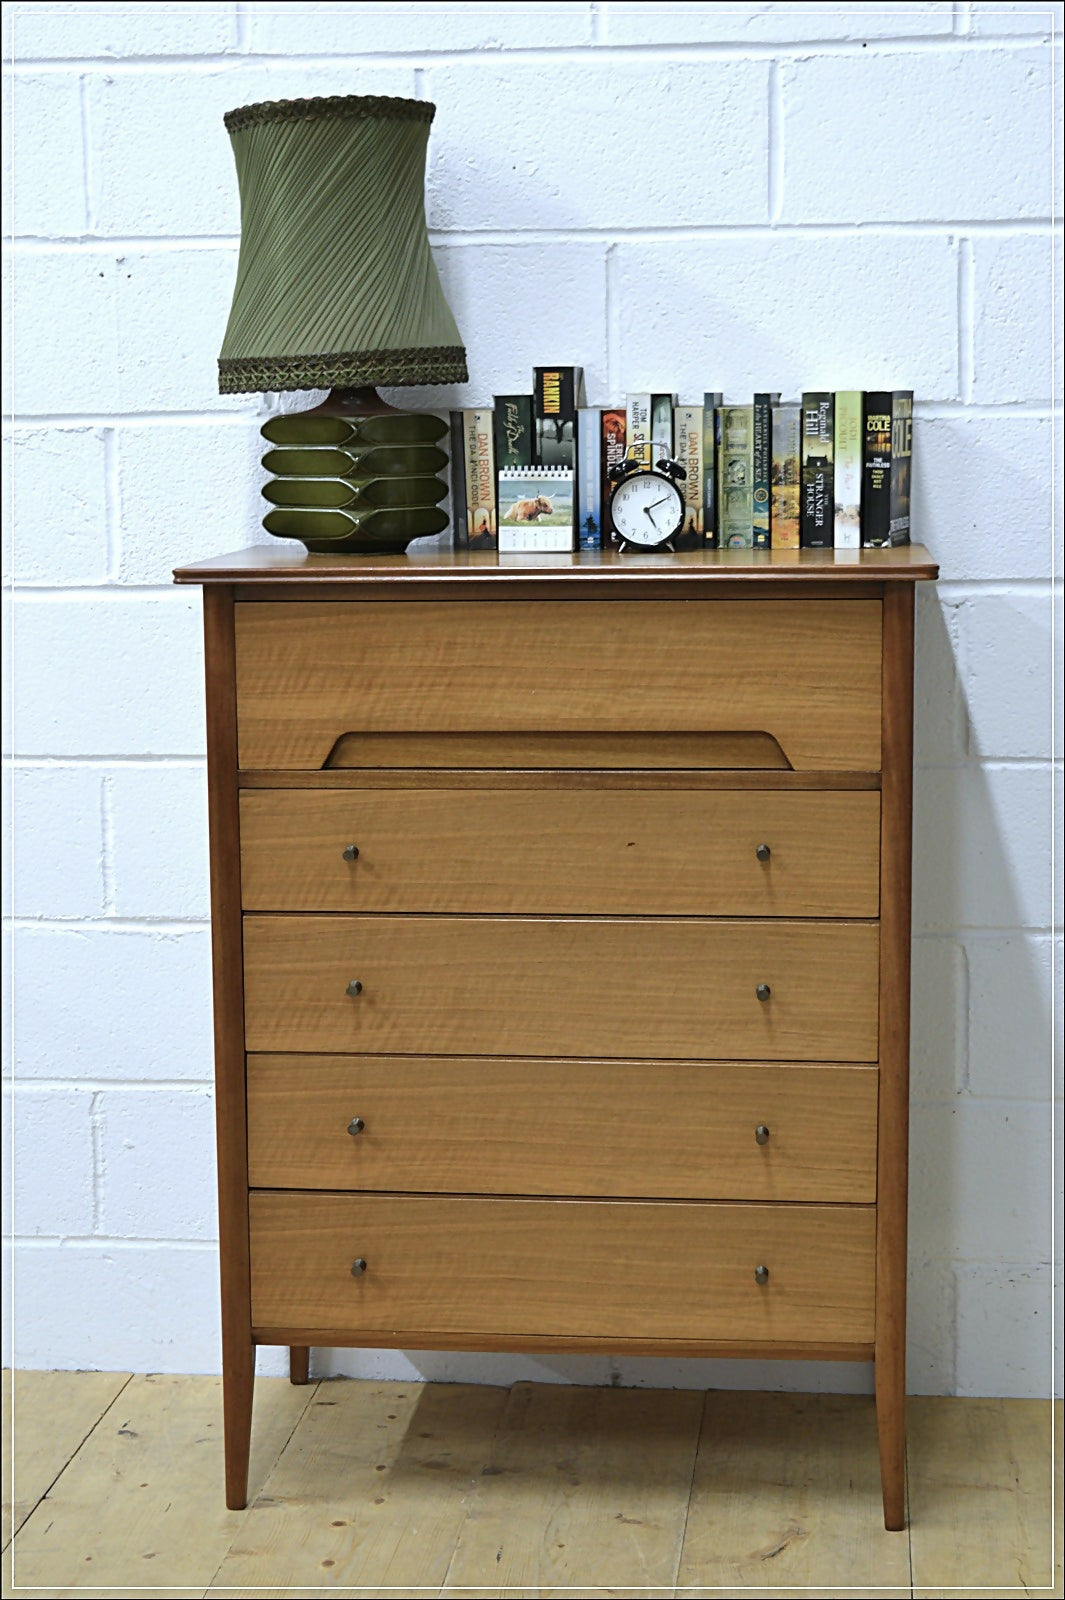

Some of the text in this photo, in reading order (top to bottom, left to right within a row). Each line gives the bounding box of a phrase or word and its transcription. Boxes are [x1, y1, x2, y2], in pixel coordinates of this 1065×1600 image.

[543, 372, 560, 414] RANKIN
[632, 402, 640, 430] HARPER
[640, 408, 648, 422] TOM
[806, 410, 818, 436] Hill
[818, 402, 830, 443] Reginald
[867, 420, 890, 432] COLE
[468, 426, 476, 442] THE
[850, 416, 858, 441] JODI
[470, 444, 477, 455] DA
[506, 430, 520, 455] Death
[680, 442, 687, 454] DA
[478, 433, 491, 502] DAN BROWN
[688, 432, 699, 500] DAN BROWN
[632, 484, 638, 492] 11
[644, 480, 650, 488] 12
[471, 486, 480, 508] CODE
[806, 484, 815, 518] HOUSE
[815, 473, 823, 526] STRANGER
[617, 506, 622, 514] 9
[632, 528, 636, 536] 7
[643, 531, 648, 539] 6
